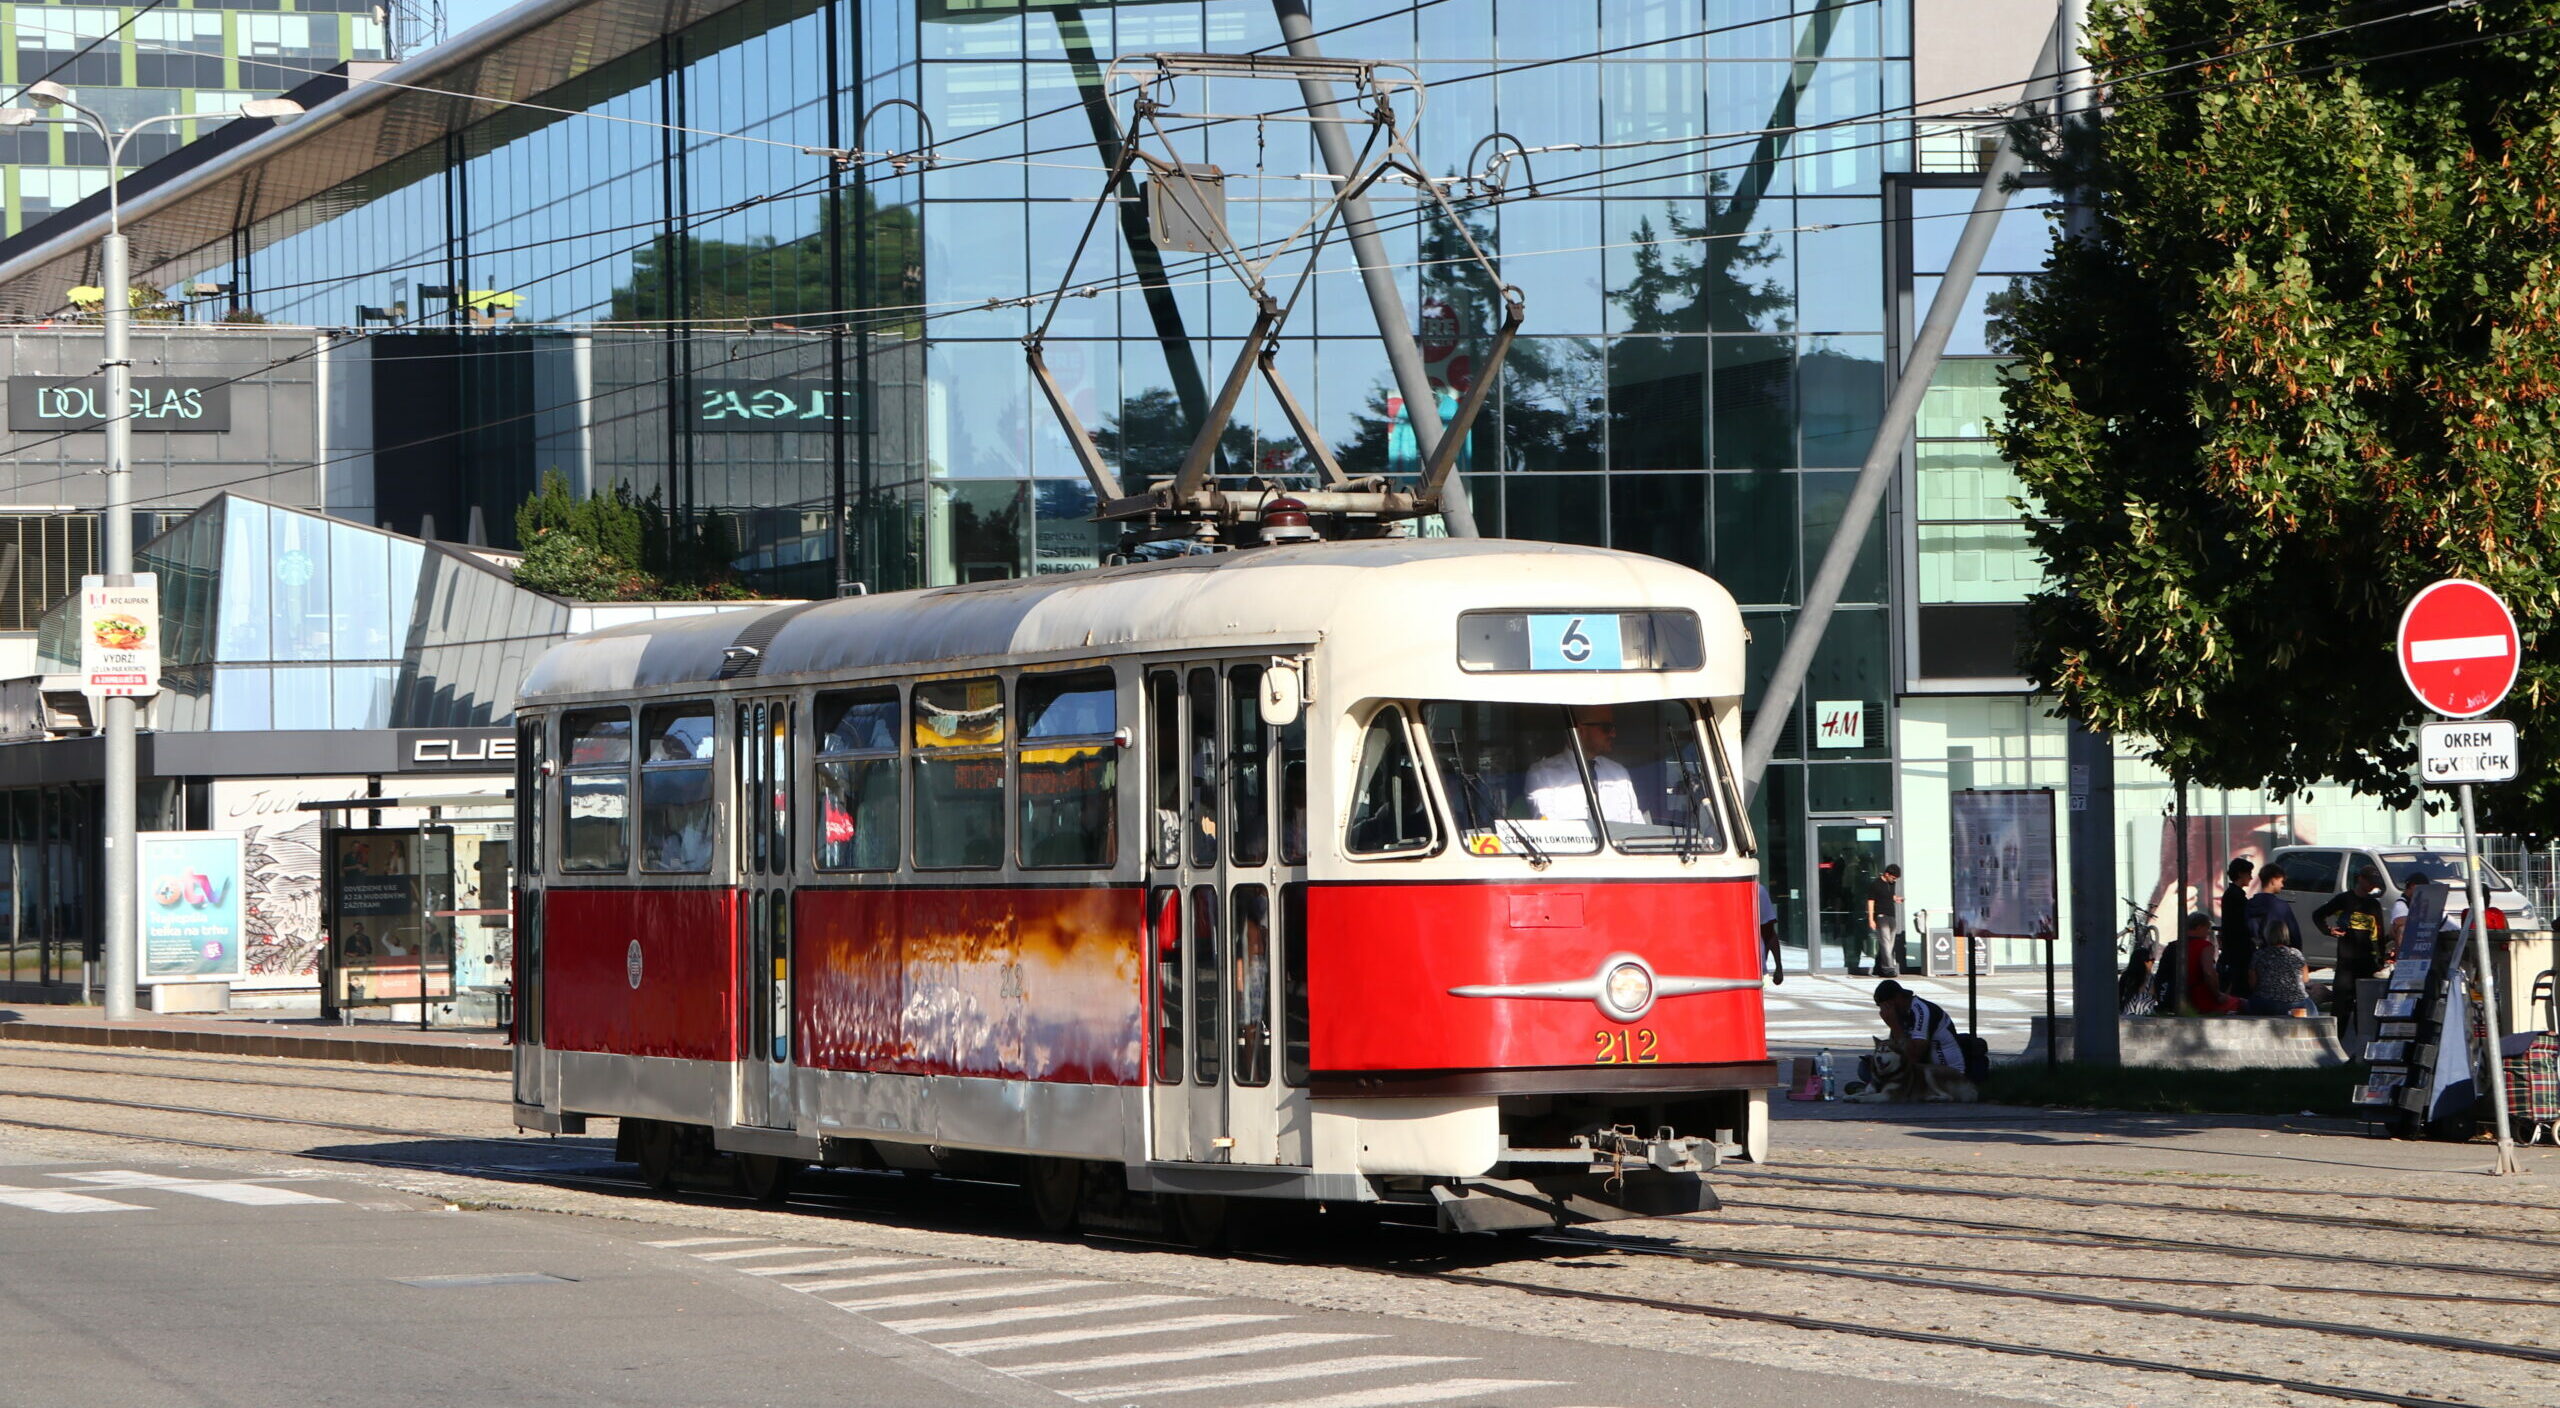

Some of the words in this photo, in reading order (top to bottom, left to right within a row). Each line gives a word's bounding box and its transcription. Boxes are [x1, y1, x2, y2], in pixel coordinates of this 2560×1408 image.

[1561, 618, 1592, 662] 6
[1822, 711, 1859, 737] H&M
[2444, 732, 2492, 748] OKREM
[1478, 837, 1500, 854] 6
[1595, 1028, 1659, 1064] 212
